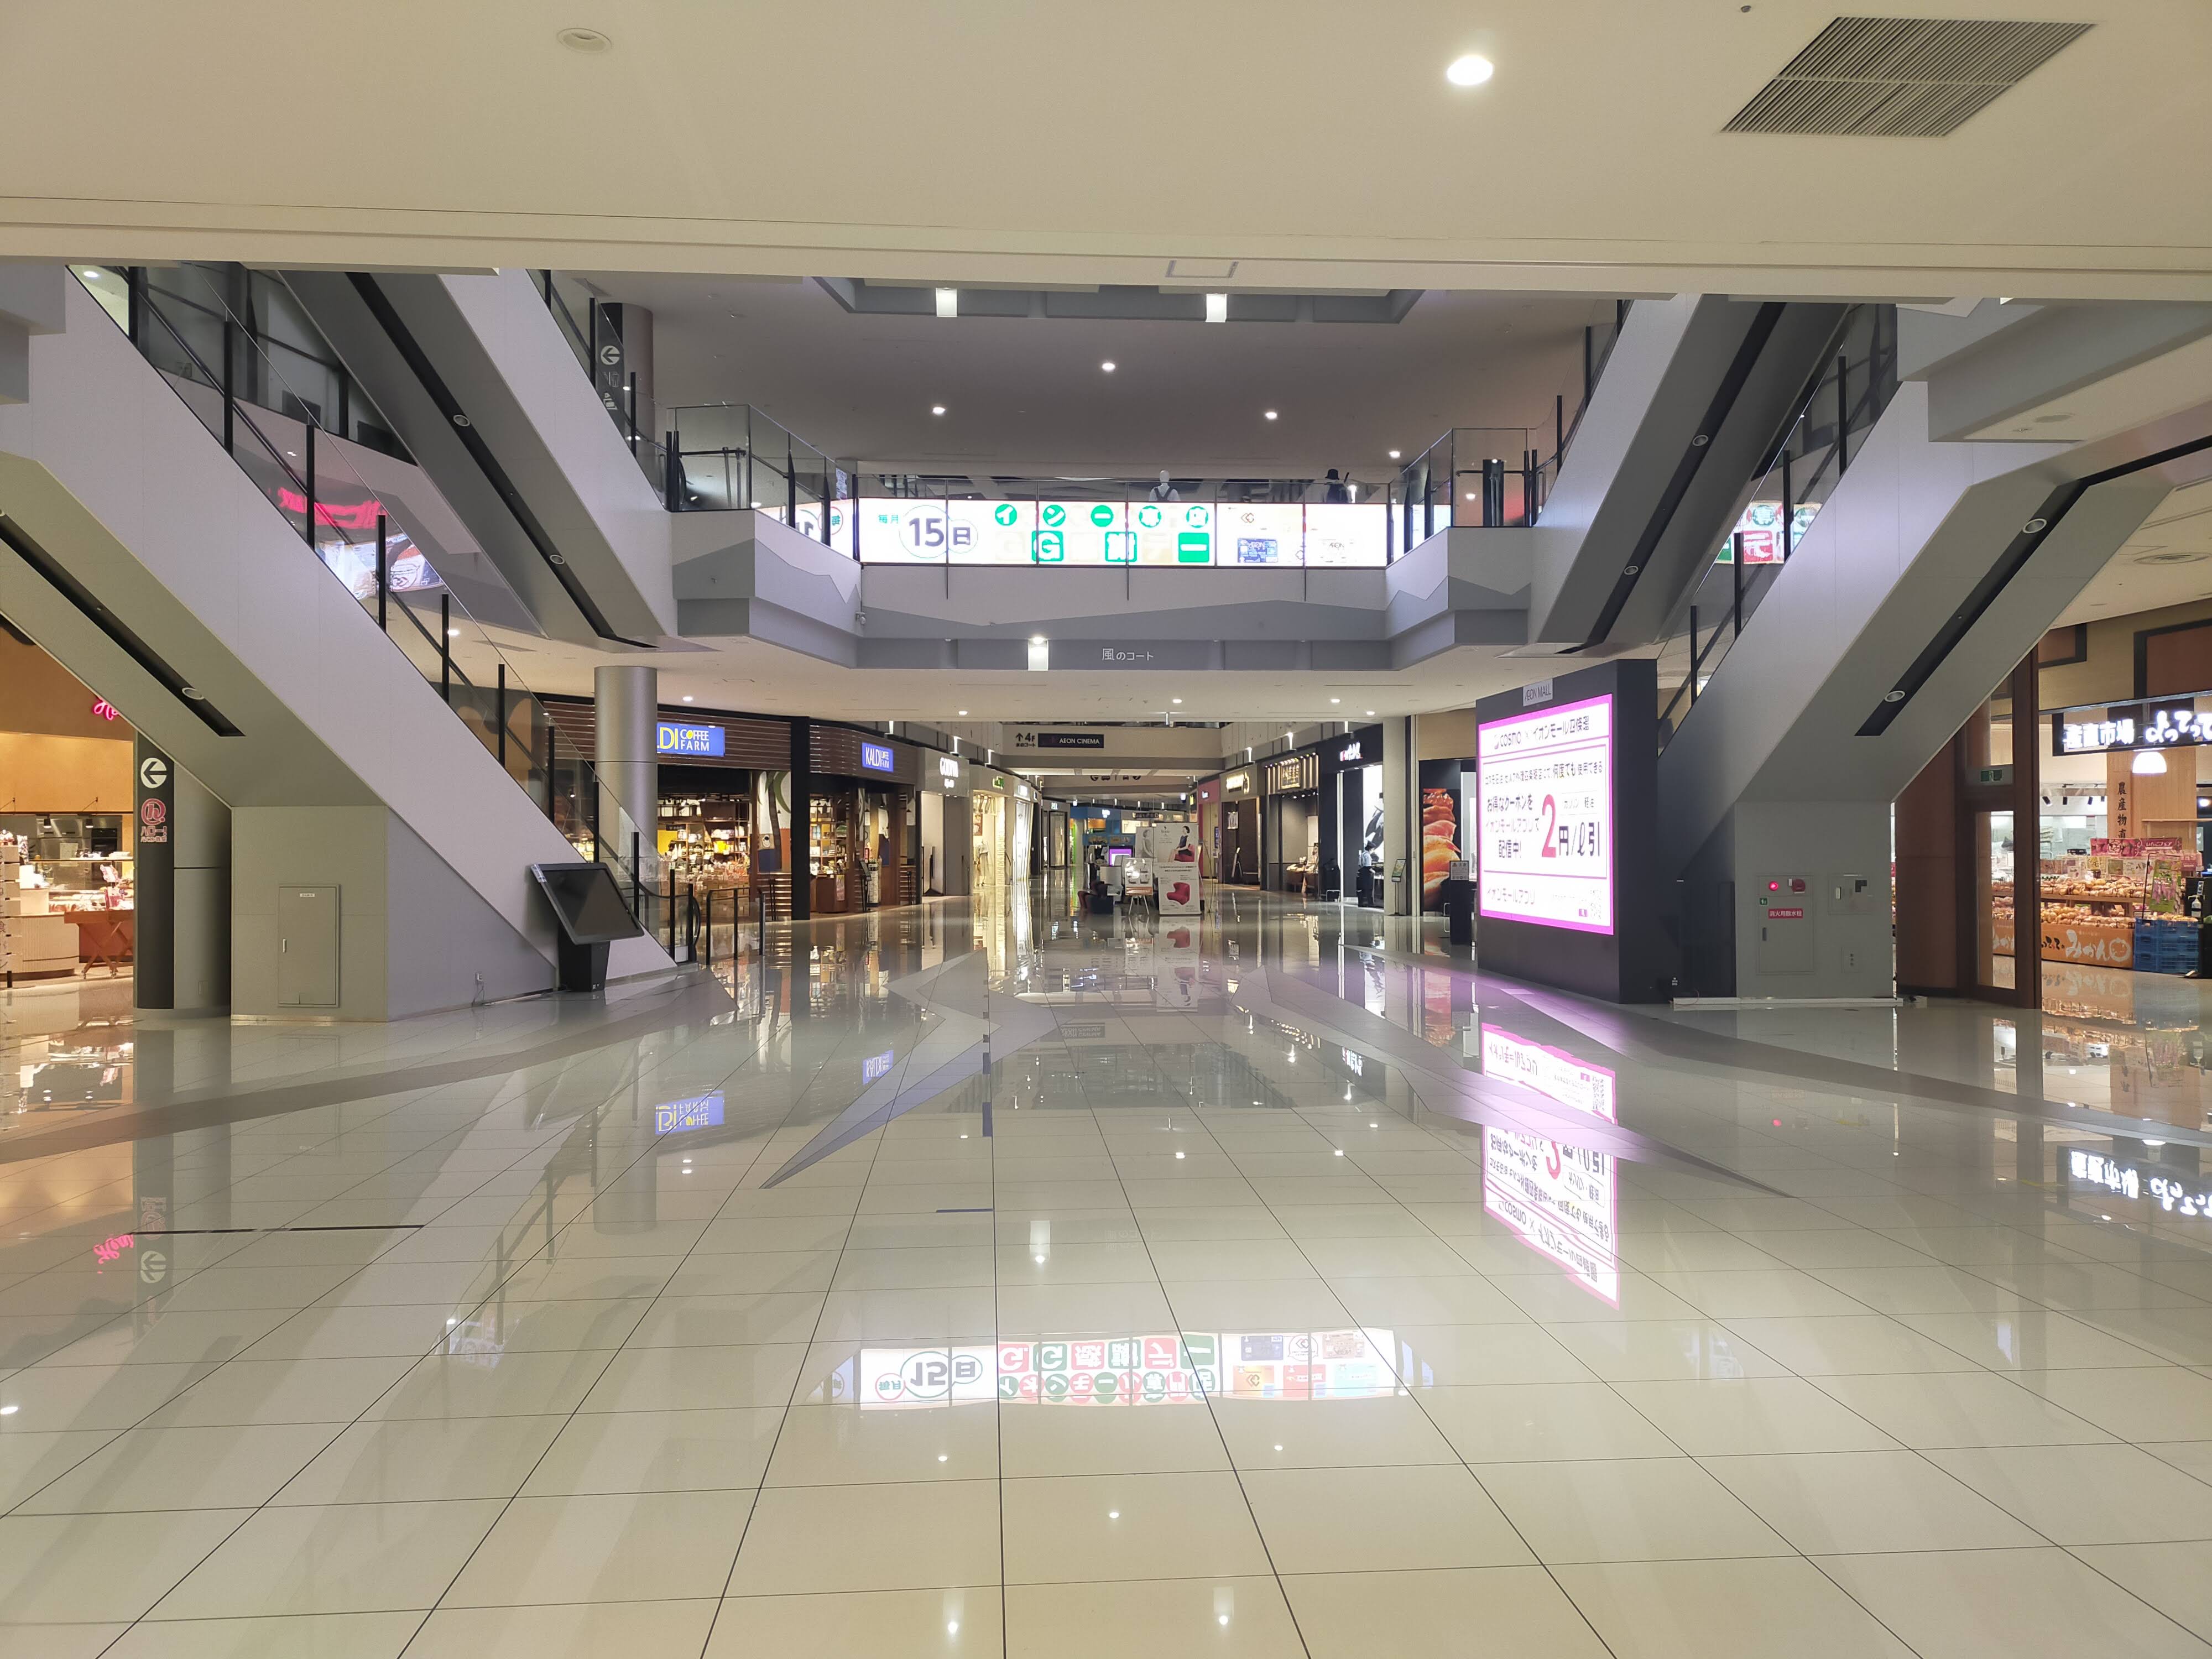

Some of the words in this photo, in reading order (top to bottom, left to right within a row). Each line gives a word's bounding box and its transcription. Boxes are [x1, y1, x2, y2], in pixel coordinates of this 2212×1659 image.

[1102, 648, 1154, 661] 風のコート
[1538, 682, 1552, 699] MALL
[680, 729, 709, 740] COFFEE
[680, 739, 709, 752] FARM
[865, 747, 881, 767] KALDI
